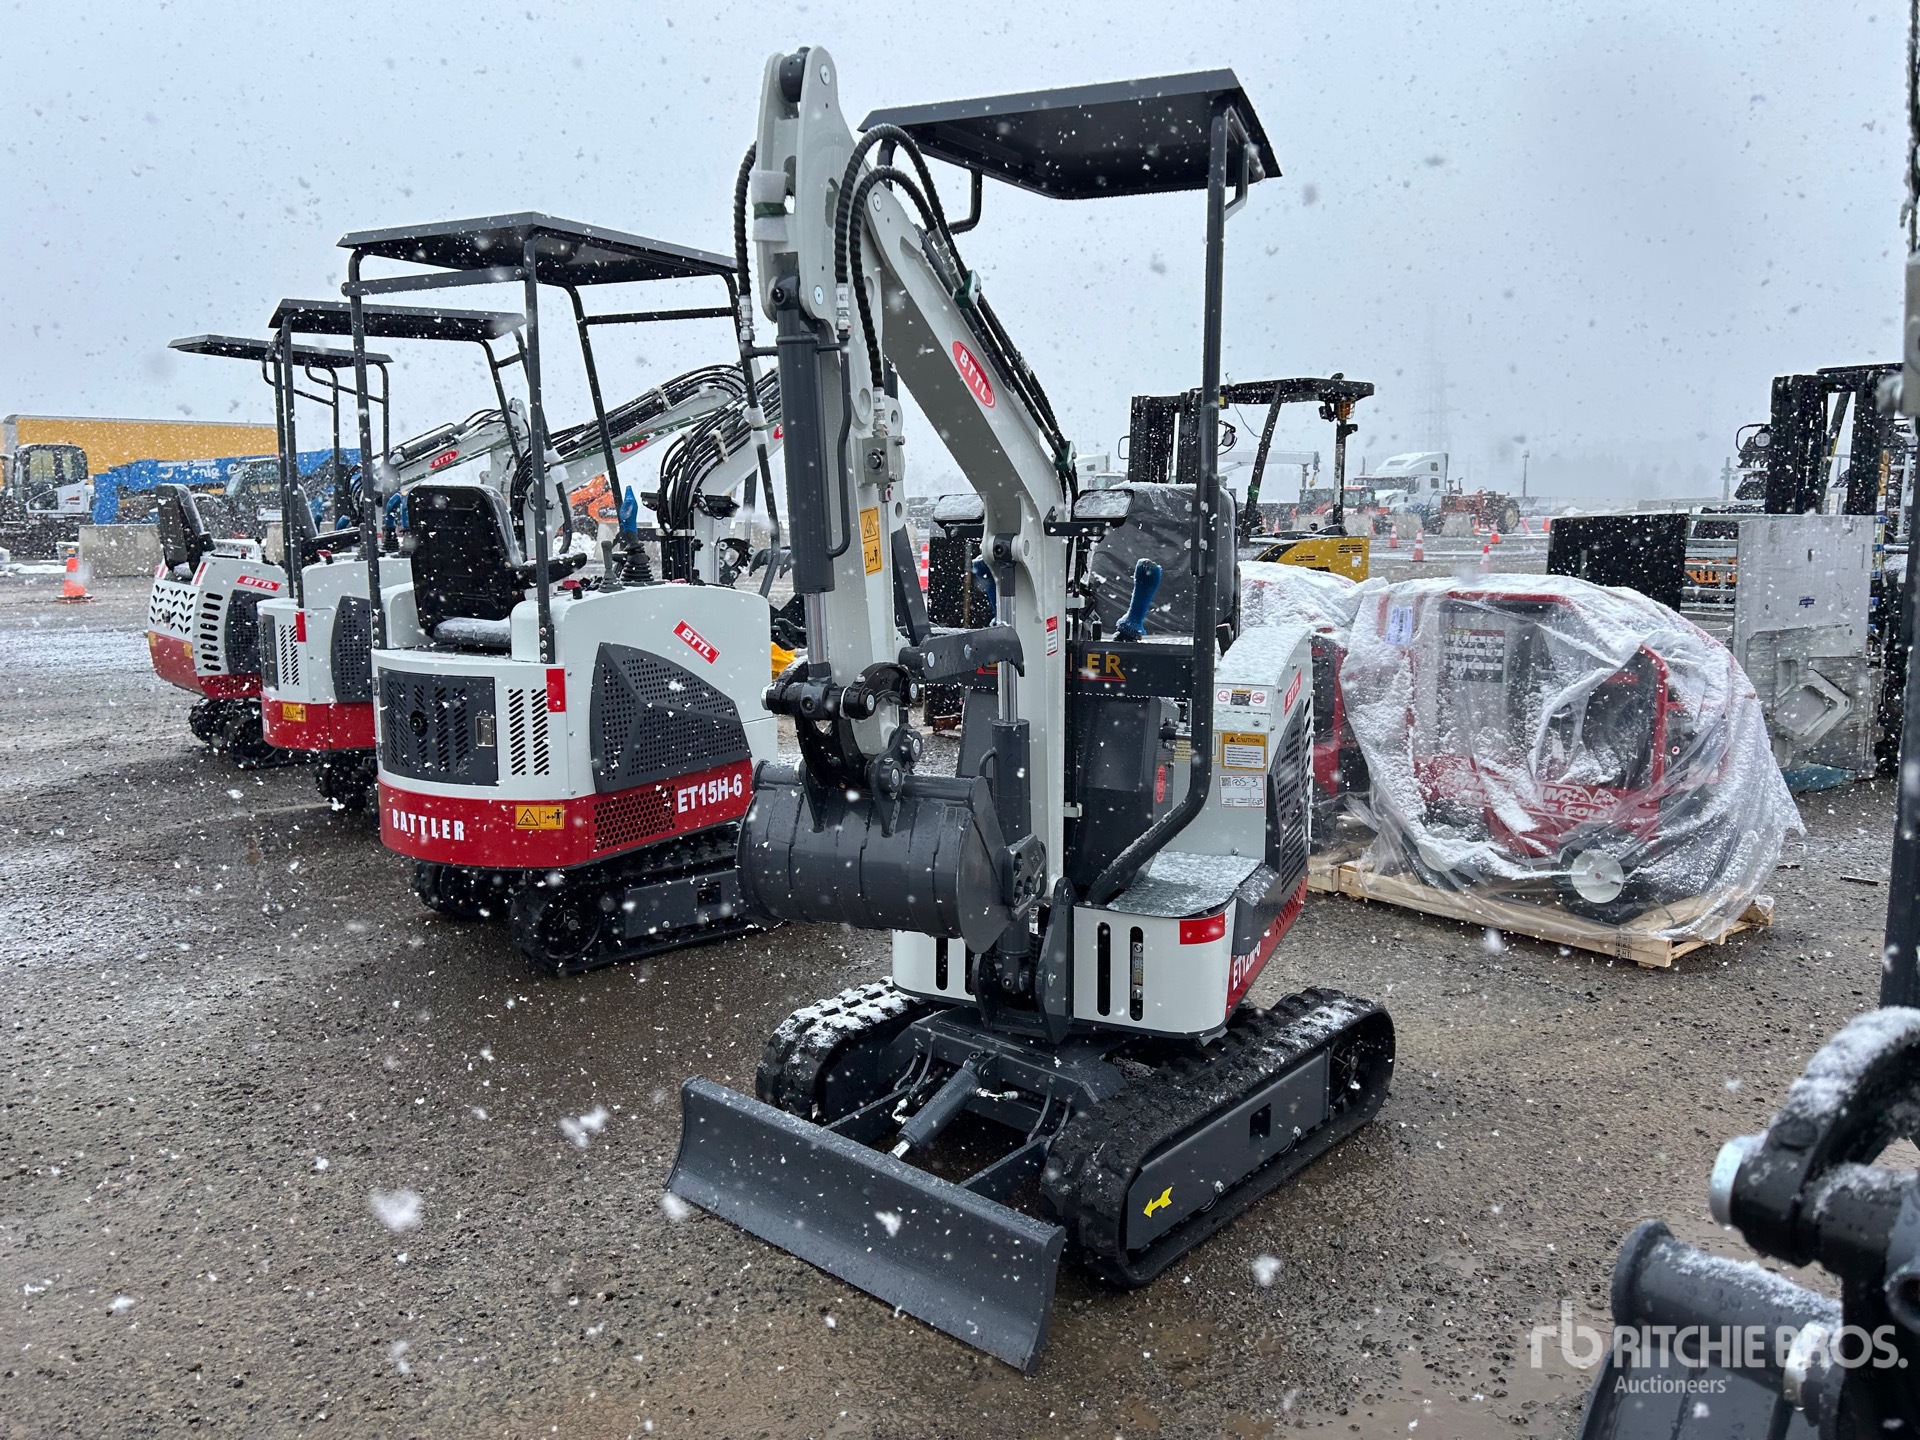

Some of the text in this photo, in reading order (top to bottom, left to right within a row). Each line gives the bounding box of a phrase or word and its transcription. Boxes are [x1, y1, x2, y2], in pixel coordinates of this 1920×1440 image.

[960, 349, 986, 401] BTTL
[434, 453, 454, 466] BTTL
[243, 577, 274, 589] BTTL
[681, 628, 710, 658] BTTL
[677, 773, 743, 813] ET15H-6
[392, 808, 465, 841] BATTLER
